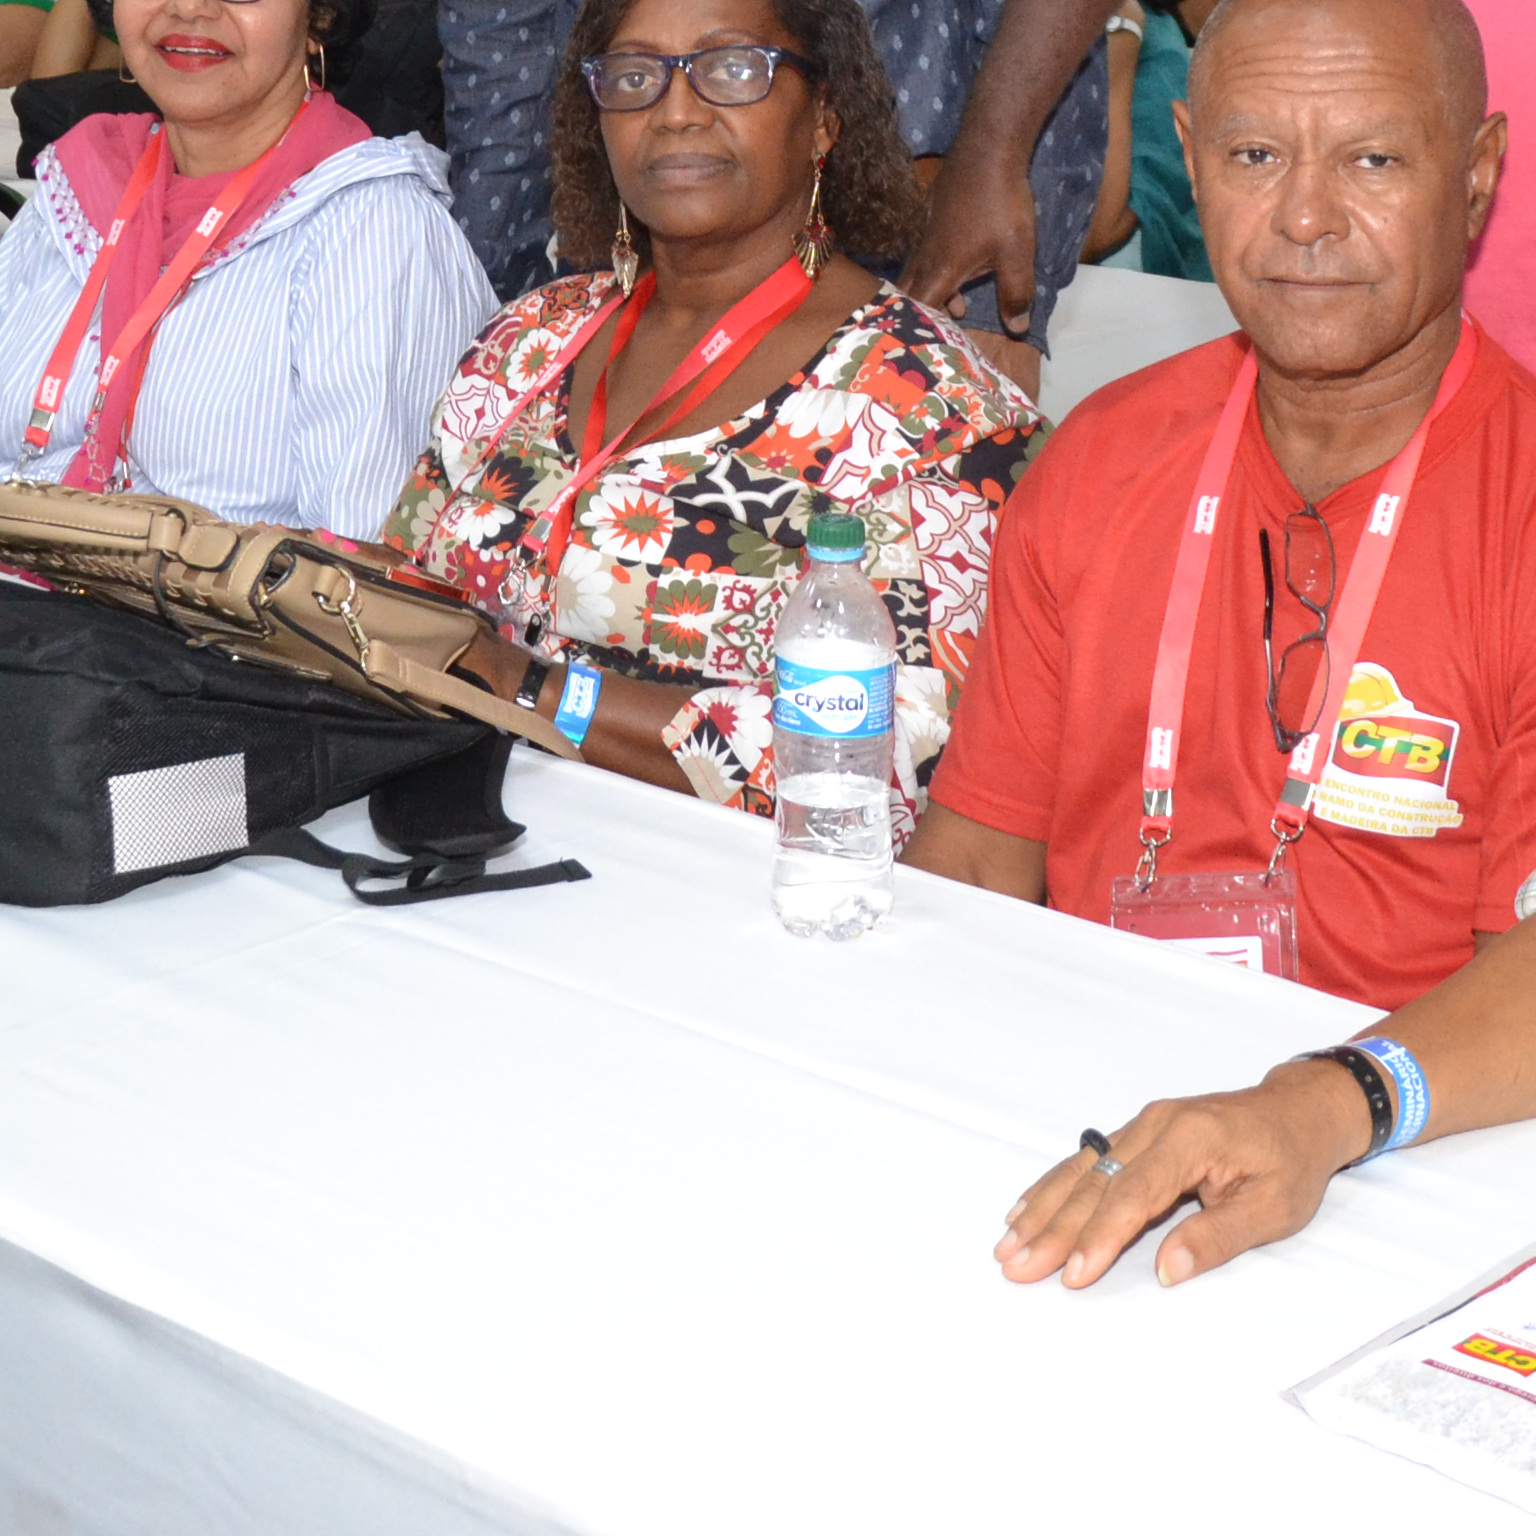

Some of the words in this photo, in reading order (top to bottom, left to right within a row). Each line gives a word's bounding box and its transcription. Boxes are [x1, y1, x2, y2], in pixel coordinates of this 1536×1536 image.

[1341, 719, 1445, 774] CTB
[1319, 791, 1355, 809] RAMO
[1358, 801, 1375, 814] DA
[1378, 807, 1462, 825] CONSTRUÇÃO
[1324, 778, 1391, 802] ENCONTRO
[1394, 795, 1457, 811] NACIONAL
[1330, 809, 1388, 833] MADEIRA
[1391, 821, 1409, 835] DA
[1412, 824, 1435, 835] CTB
